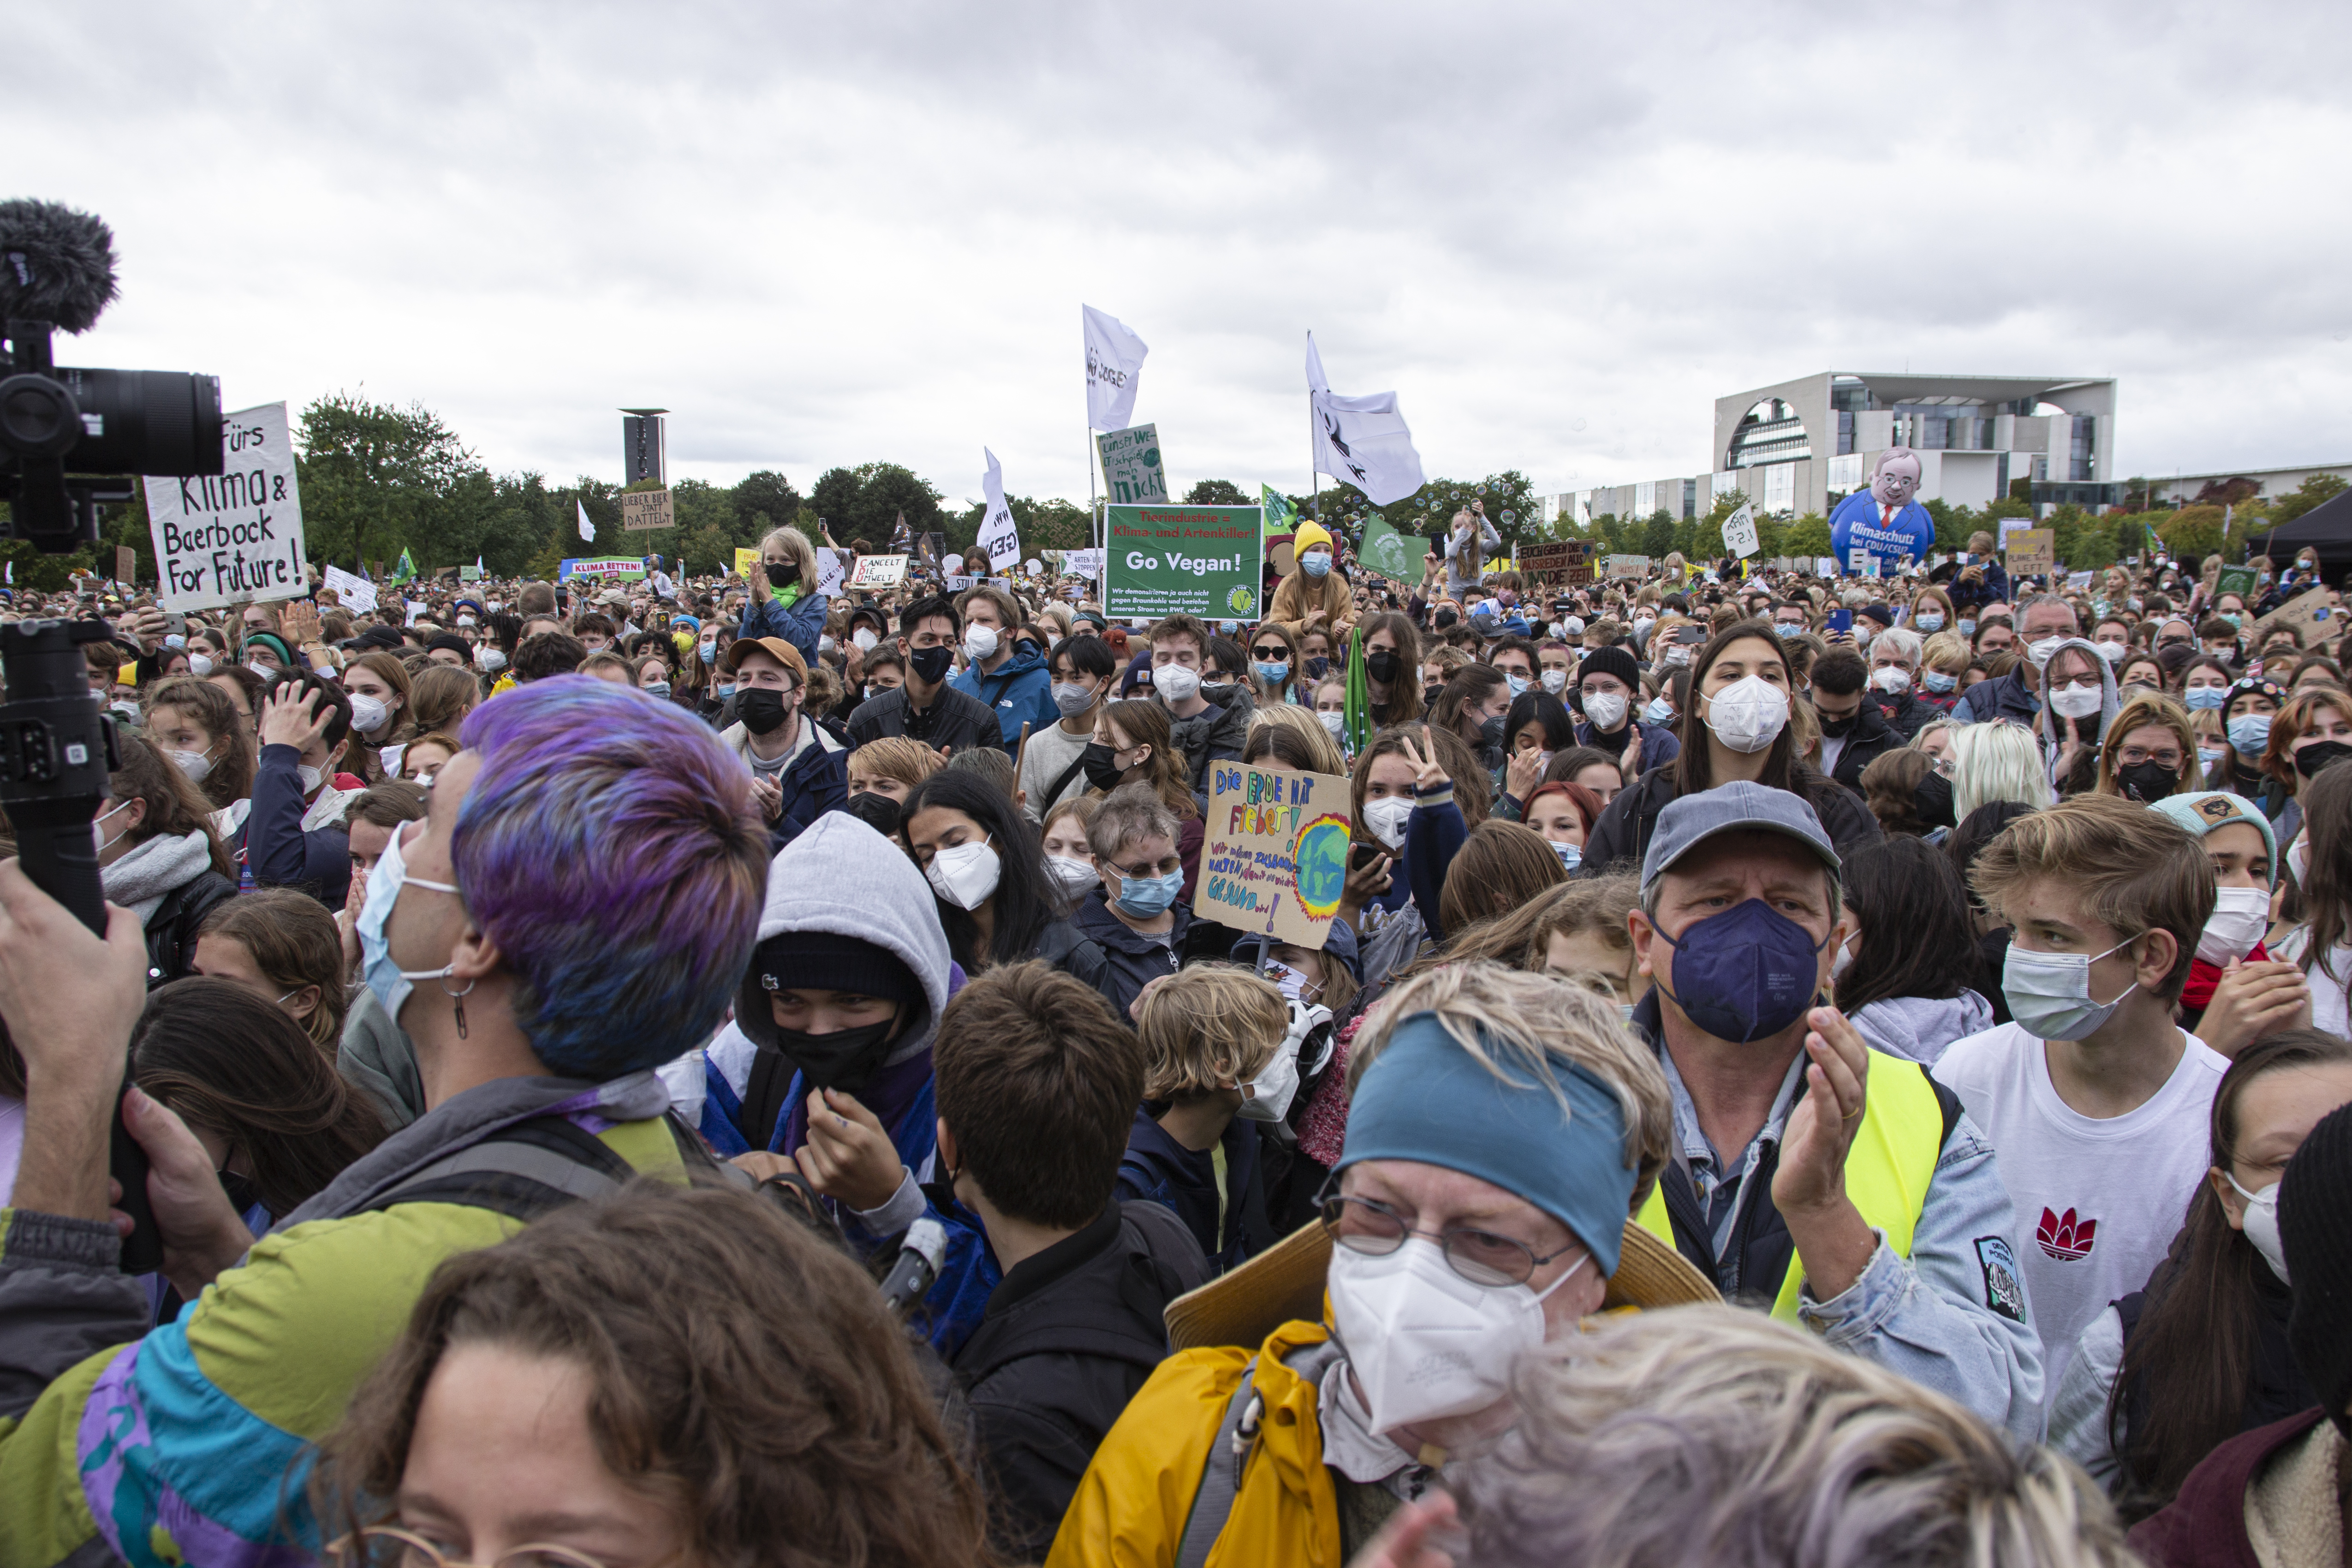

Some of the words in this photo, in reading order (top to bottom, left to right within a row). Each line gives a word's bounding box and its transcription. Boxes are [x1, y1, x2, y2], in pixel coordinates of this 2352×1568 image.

[1099, 363, 1127, 389] JUGE
[1103, 436, 1132, 453] unser
[1117, 468, 1138, 478] man
[179, 469, 267, 516] Klima
[273, 475, 287, 501] &
[1113, 468, 1167, 504] nicht
[624, 494, 649, 507] LIEBER
[652, 493, 668, 503] BIER
[642, 503, 662, 512] STATT
[1139, 511, 1218, 523] Tierindustrie
[163, 508, 275, 555] Baerbock
[1113, 525, 1152, 537] Klima-
[1156, 526, 1179, 537] und
[1183, 527, 1255, 539] Artenkiller!
[1850, 521, 1915, 545] Klimaschutz
[1521, 545, 1543, 559] EUCH
[1545, 544, 1566, 554] GEHEN
[1568, 543, 1580, 554] DIE
[1850, 535, 1864, 547] bei
[1865, 540, 1909, 554] CDU/CSU?
[167, 559, 206, 595] For
[212, 537, 303, 596] Future!
[575, 563, 605, 572] KLIMA
[606, 562, 640, 571] RETTEN!
[860, 559, 901, 568] CANCELT
[1126, 551, 1158, 570] Go
[1165, 553, 1241, 576] Vegan!
[1521, 556, 1566, 571] AUSREDEN
[1567, 554, 1584, 567] AUS
[1612, 556, 1628, 564] NOT
[1628, 556, 1647, 566] COOL
[2017, 564, 2043, 572] LEFT
[1548, 569, 1567, 585] DIE
[1228, 587, 1237, 607] VEGANS
[1241, 598, 1256, 615] FUTURE
[1216, 768, 1242, 795] Die
[1247, 771, 1283, 805] ERDE
[1291, 777, 1315, 807] HAT
[1211, 841, 1228, 855] Wir
[1243, 861, 1266, 881] damit
[1266, 873, 1276, 882] sie
[1208, 875, 1257, 911] GESUND
